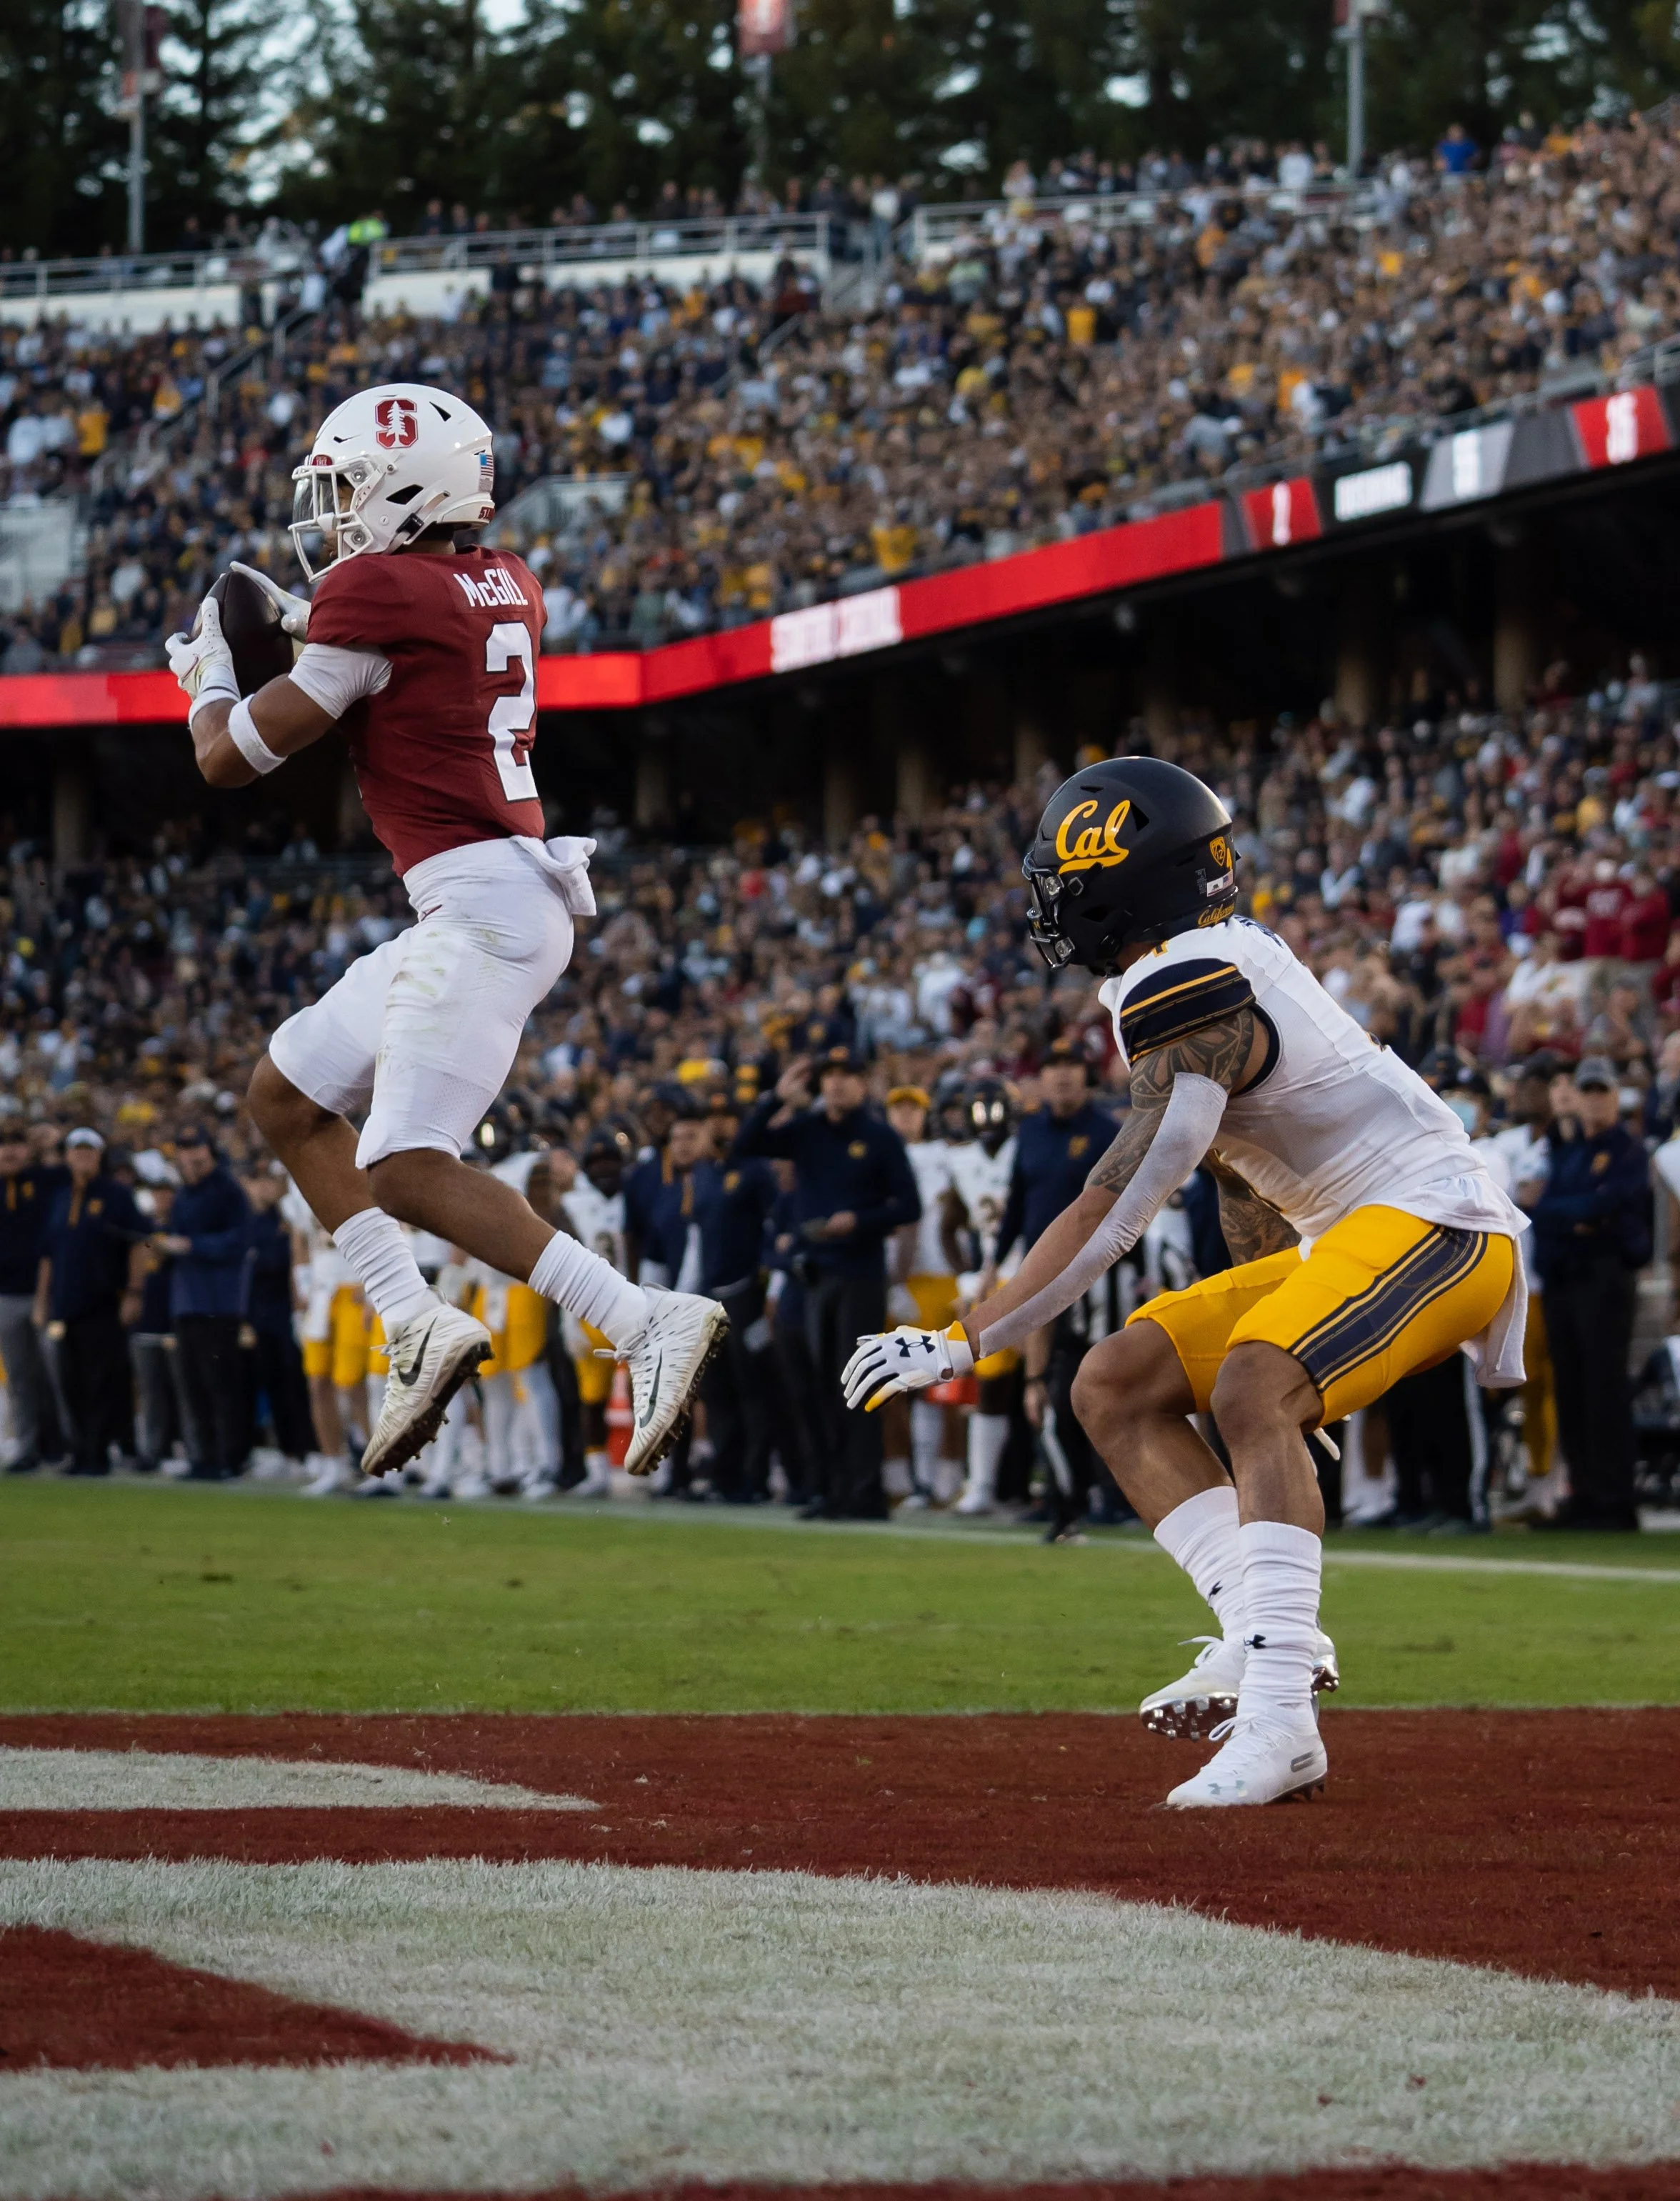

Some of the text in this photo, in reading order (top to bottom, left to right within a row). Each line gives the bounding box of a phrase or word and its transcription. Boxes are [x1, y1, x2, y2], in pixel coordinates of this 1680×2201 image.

[453, 568, 529, 607] McGILL
[486, 620, 539, 802] 2
[1056, 799, 1131, 874] Cal
[1197, 902, 1235, 928] Califor
